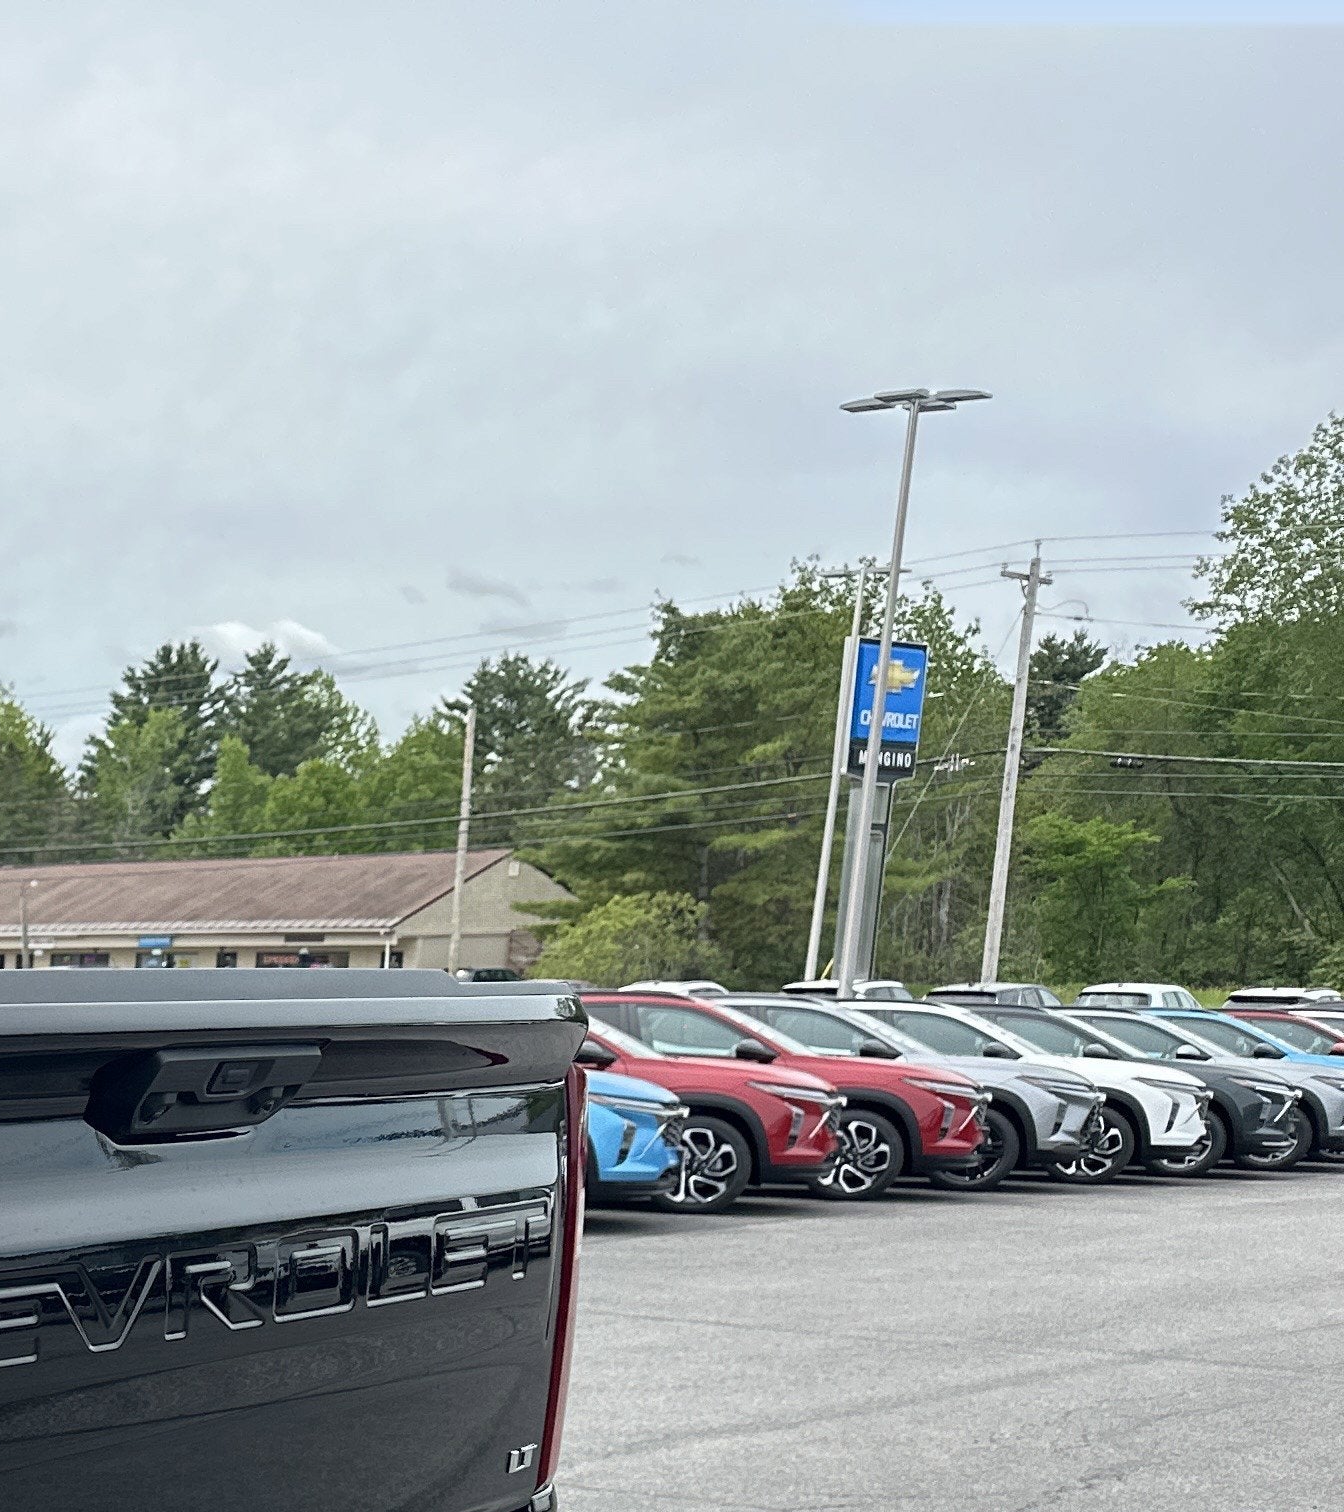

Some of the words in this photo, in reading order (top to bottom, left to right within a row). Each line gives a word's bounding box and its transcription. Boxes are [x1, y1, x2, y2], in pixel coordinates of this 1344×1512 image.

[860, 710, 919, 729] CHROLET
[859, 750, 912, 768] MNGINO
[506, 1443, 538, 1474] LT
